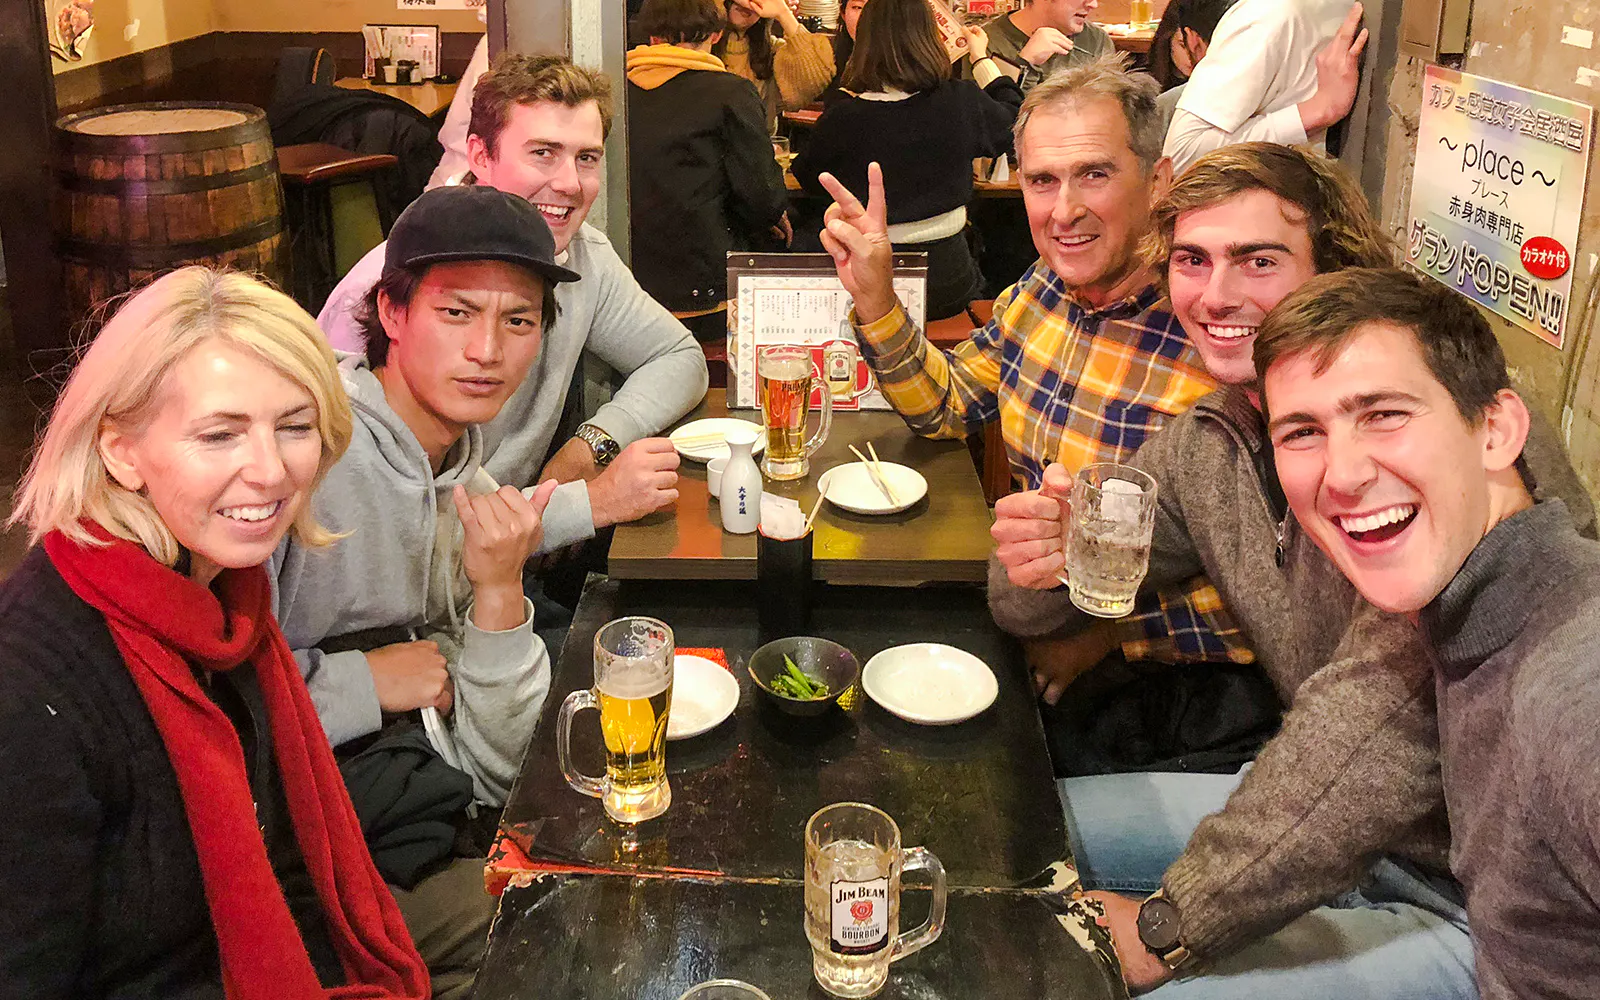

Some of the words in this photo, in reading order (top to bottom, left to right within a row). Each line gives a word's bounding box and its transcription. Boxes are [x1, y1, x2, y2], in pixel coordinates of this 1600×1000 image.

[1461, 139, 1525, 186] place
[1471, 178, 1510, 210] プレース
[1448, 195, 1525, 247] 赤身肉専門店
[1523, 246, 1567, 269] カラオケ付
[836, 889, 855, 904] JIM
[858, 887, 885, 899] BEAM
[842, 928, 880, 939] BOURBON
